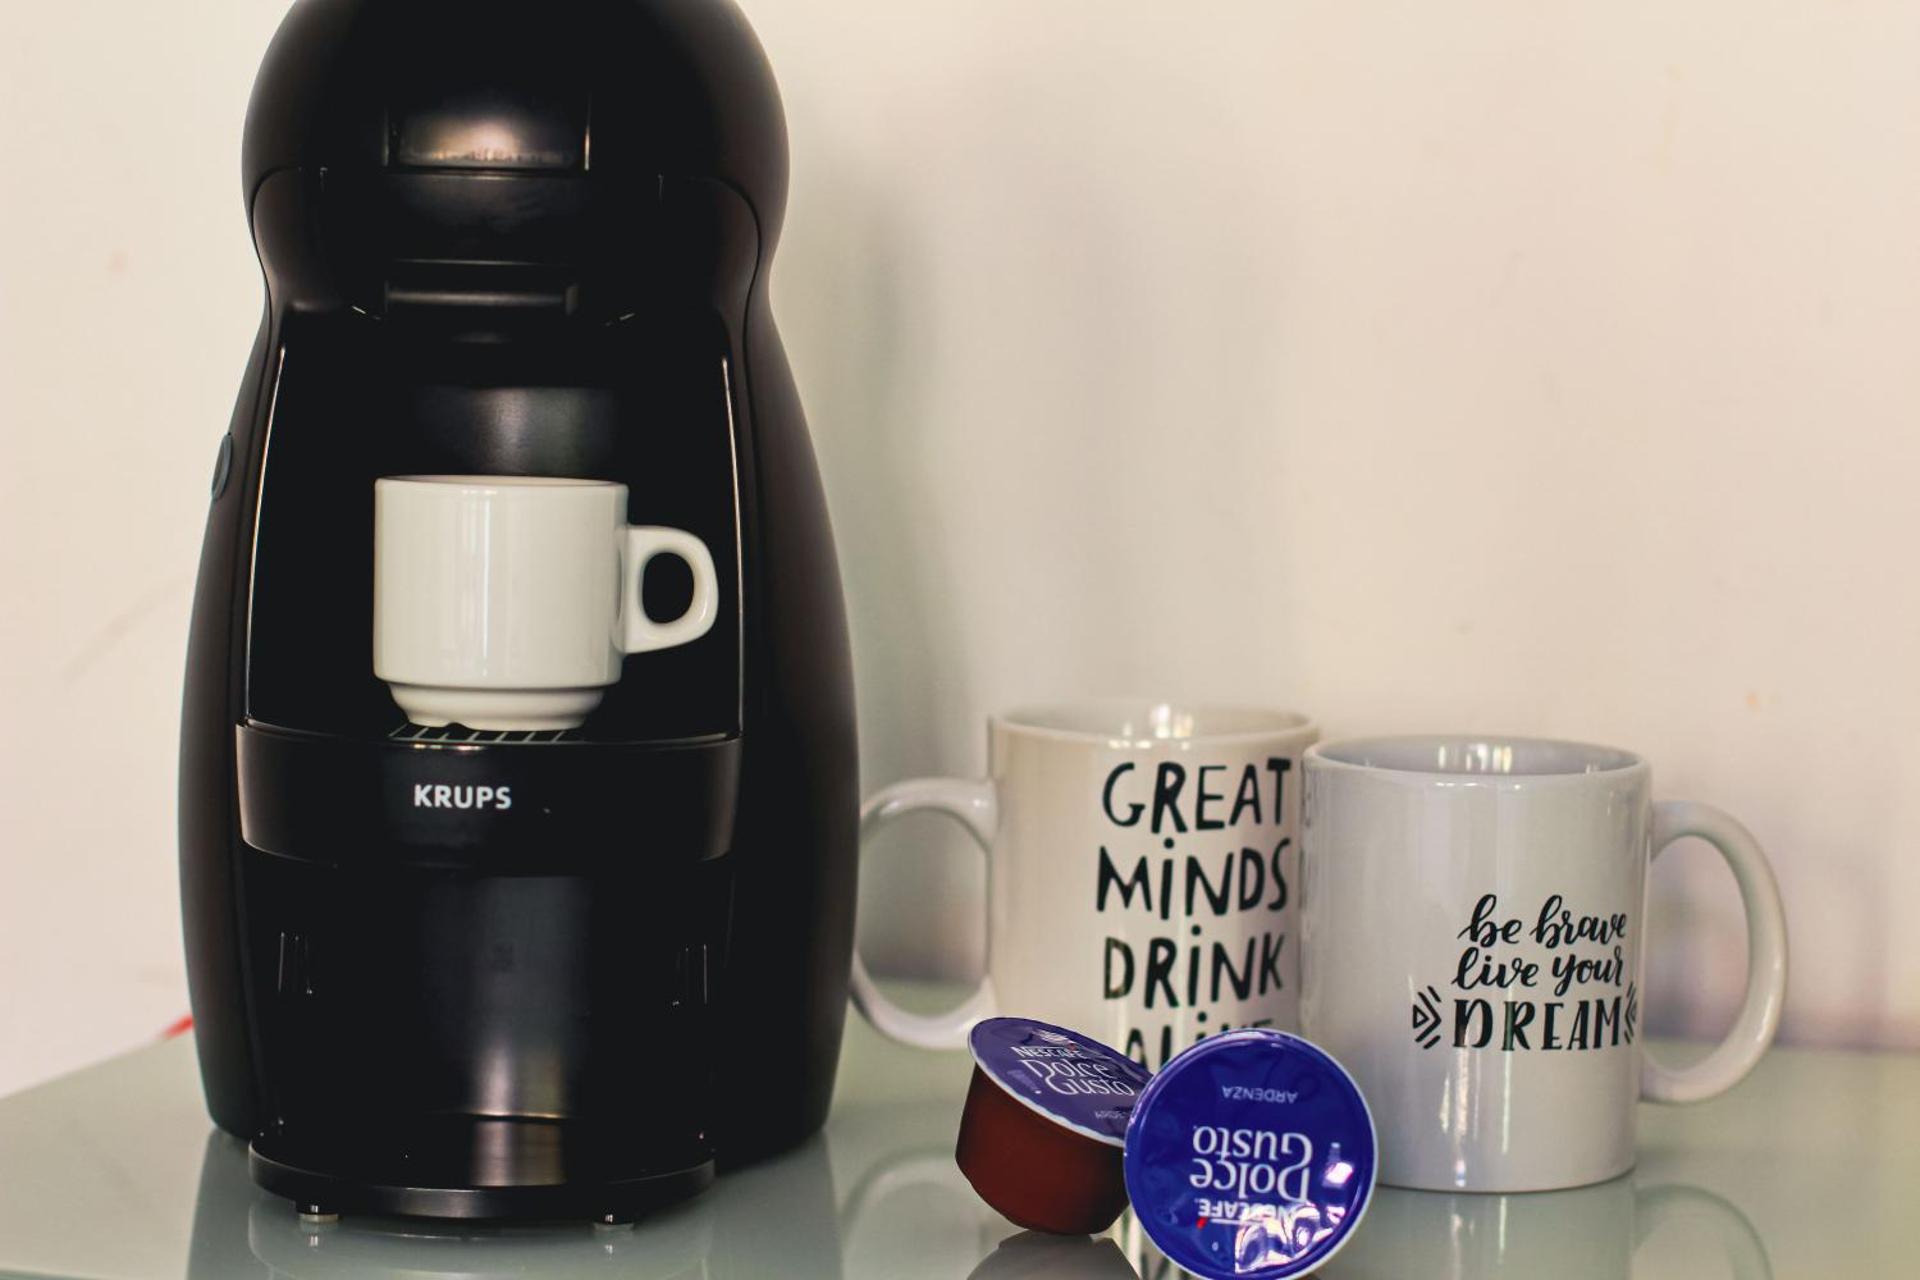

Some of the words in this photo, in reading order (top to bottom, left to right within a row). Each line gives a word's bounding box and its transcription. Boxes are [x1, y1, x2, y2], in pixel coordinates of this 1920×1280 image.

[413, 783, 512, 810] KRUPS
[1102, 757, 1291, 834] GREAT
[1457, 893, 1523, 949] be
[1529, 894, 1627, 949] brave
[1451, 946, 1540, 990] live
[1552, 945, 1624, 997] your
[1453, 996, 1622, 1052] DREAM
[1018, 1057, 1118, 1080] Dolce
[1044, 1076, 1135, 1097] Gusto
[1221, 1085, 1299, 1105] ARDENZA
[1192, 1126, 1313, 1167] Gusto
[1189, 1158, 1311, 1202] Dolce
